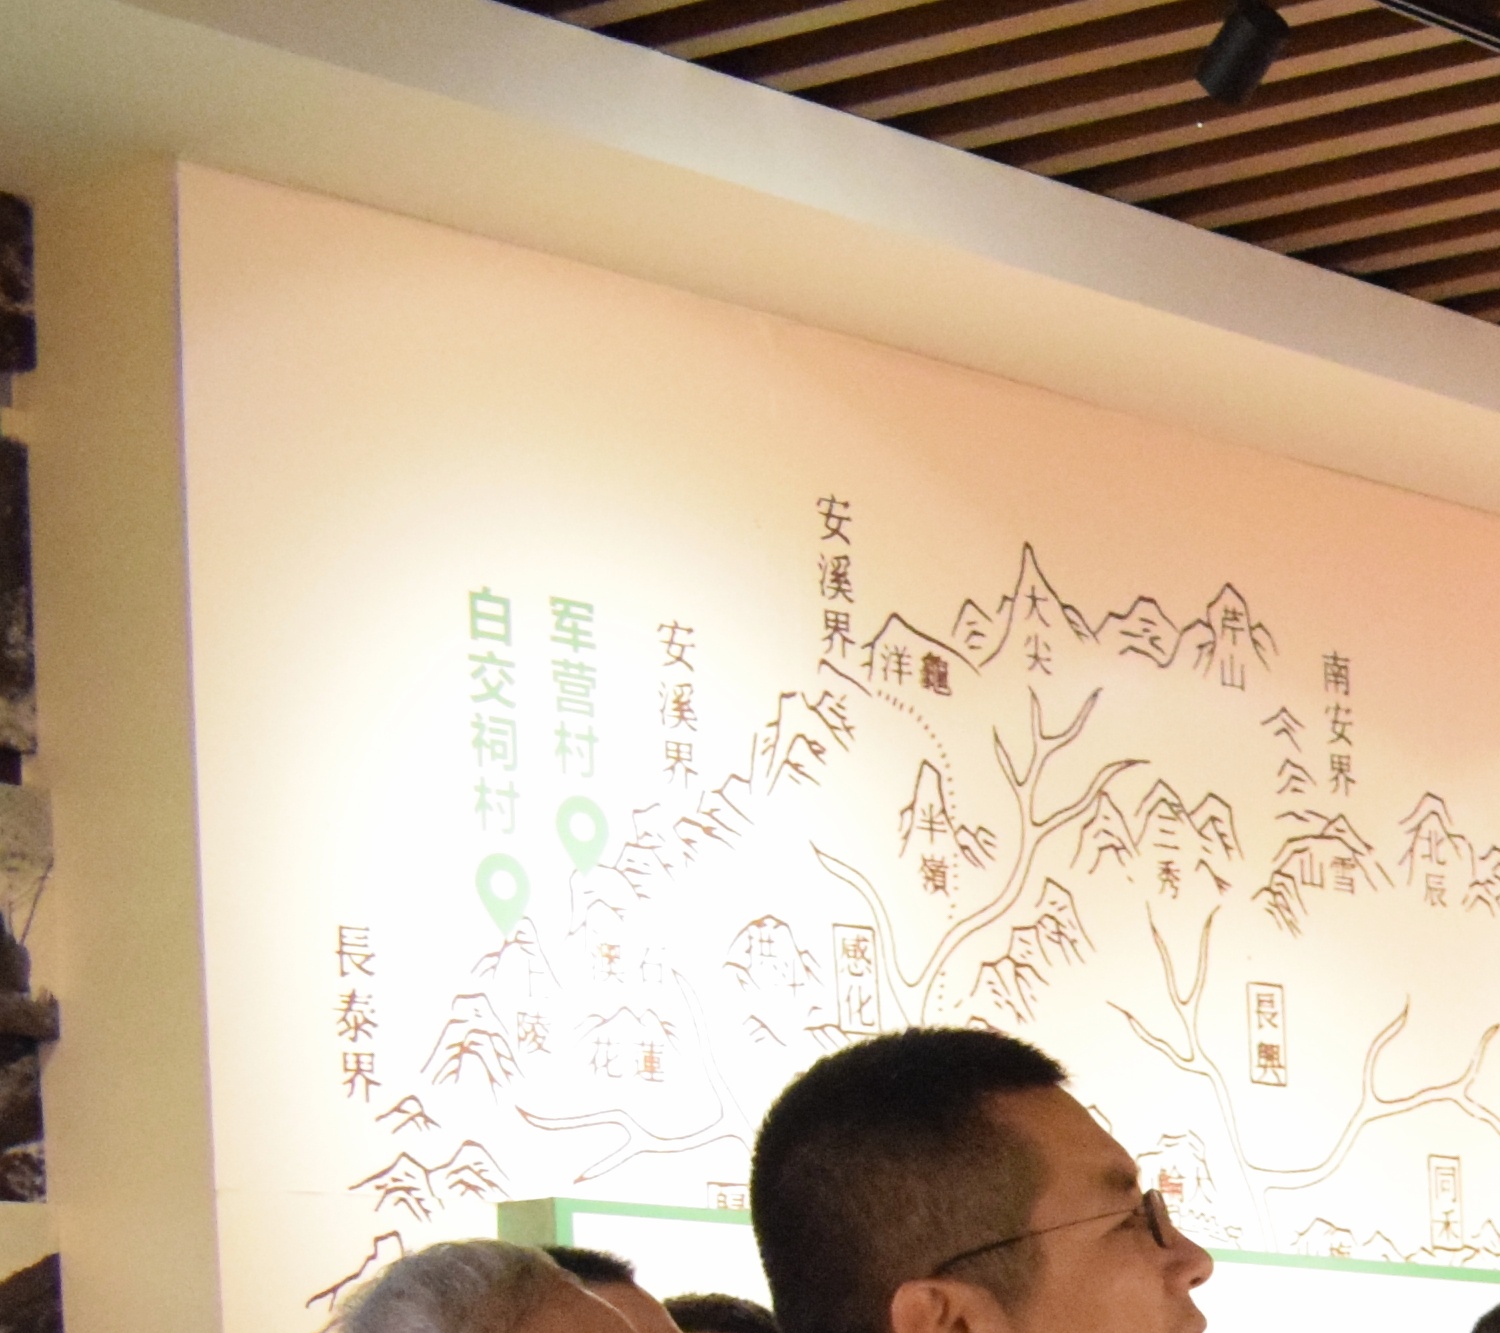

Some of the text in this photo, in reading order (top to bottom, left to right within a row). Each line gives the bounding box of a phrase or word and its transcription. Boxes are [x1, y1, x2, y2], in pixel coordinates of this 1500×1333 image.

[469, 586, 520, 837] 白交祠村
[549, 595, 600, 780] 军营村
[1323, 653, 1357, 796] 南安界
[335, 925, 382, 1102] 長泰界
